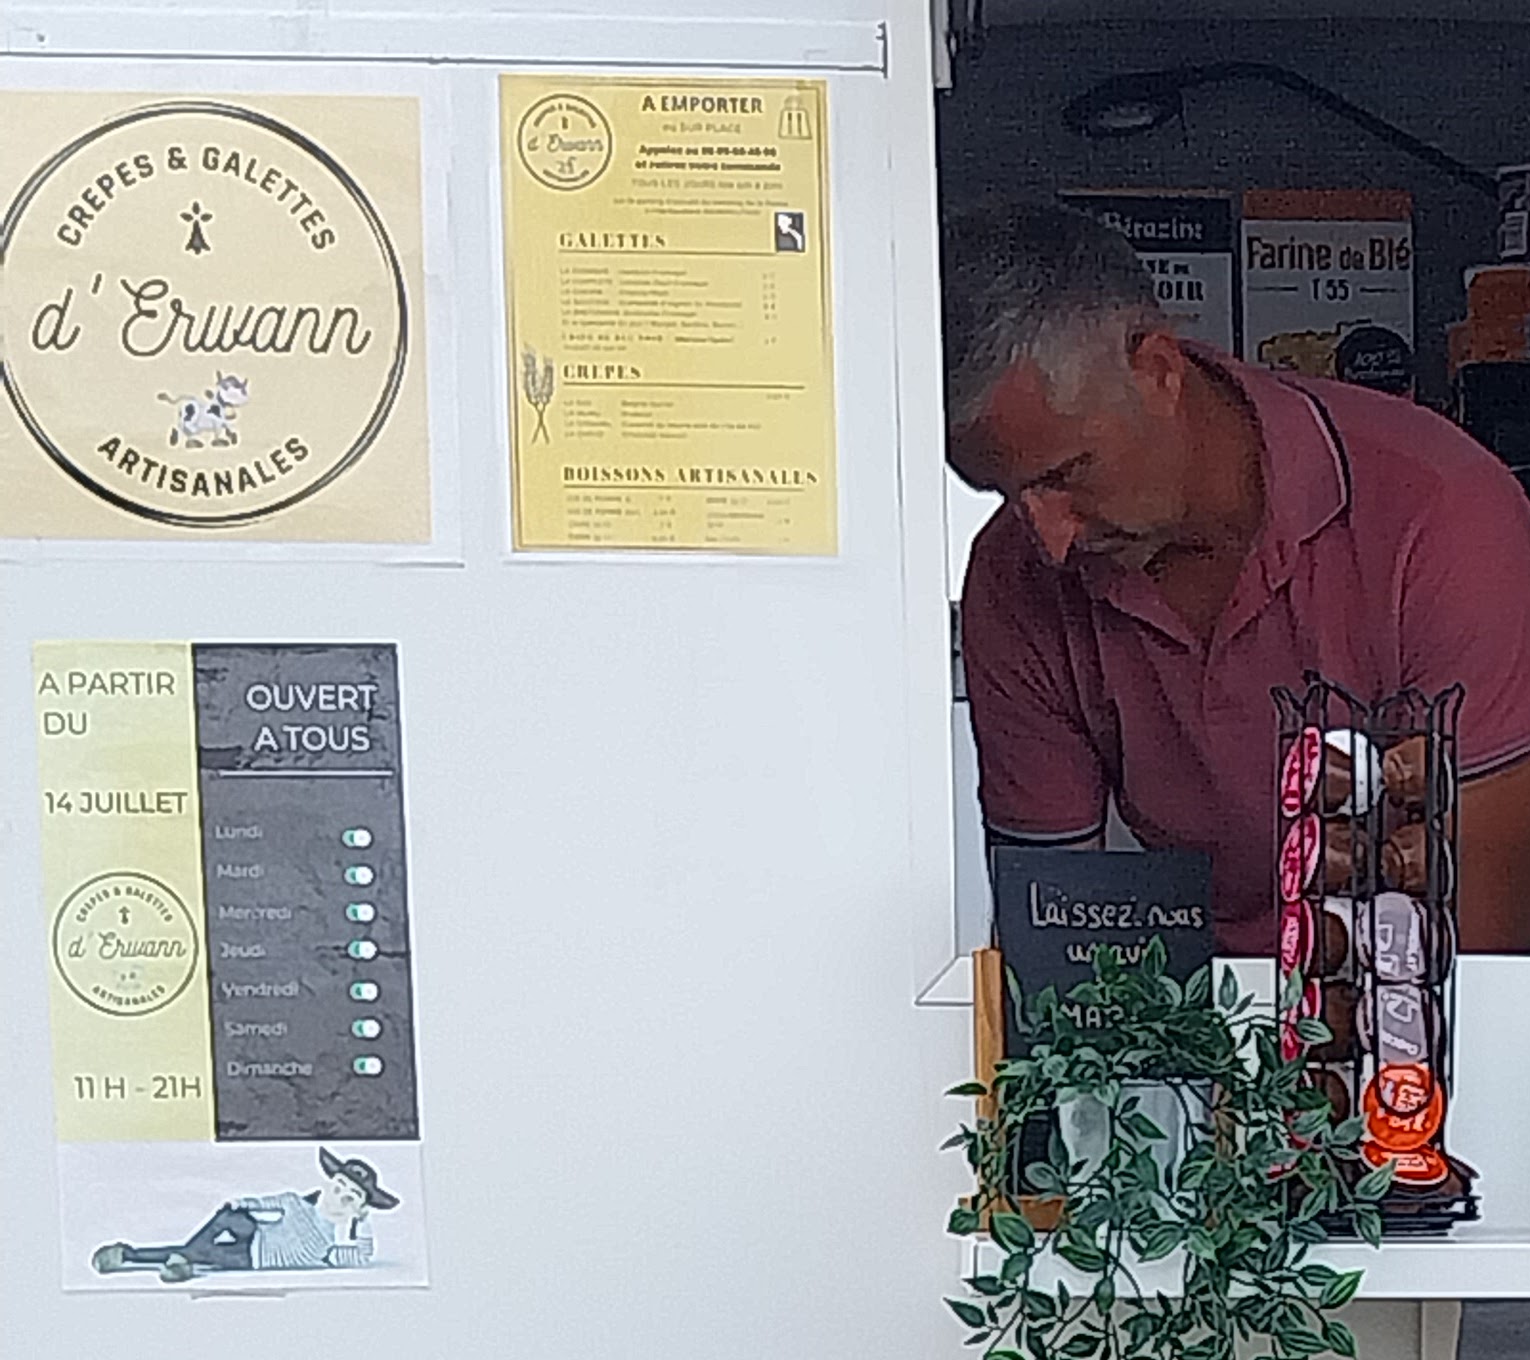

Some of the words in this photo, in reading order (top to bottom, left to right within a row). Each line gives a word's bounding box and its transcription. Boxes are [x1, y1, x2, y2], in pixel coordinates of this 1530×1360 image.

[642, 95, 656, 112] A
[661, 96, 764, 114] EMPORTER
[57, 153, 155, 247] CREPES
[167, 147, 188, 171] &
[203, 147, 337, 250] GALETTES
[559, 232, 666, 249] GALETTES
[1246, 234, 1332, 272] Farine
[1368, 236, 1411, 272] Blé
[1157, 280, 1204, 302] OIR
[1326, 278, 1350, 301] 55
[96, 436, 311, 498] ARTISANALES
[562, 465, 666, 483] BOISSONS
[677, 467, 818, 485] ARTISANALES
[38, 672, 60, 696] A
[68, 671, 175, 696] PARTIR
[245, 683, 378, 712] OUVERT
[43, 712, 88, 735] DU
[254, 726, 281, 752] A
[283, 725, 372, 753] TOUS
[44, 791, 73, 814] 14
[80, 791, 188, 814] JUILLET
[104, 1076, 126, 1099] H
[151, 1075, 202, 1099] 21H
